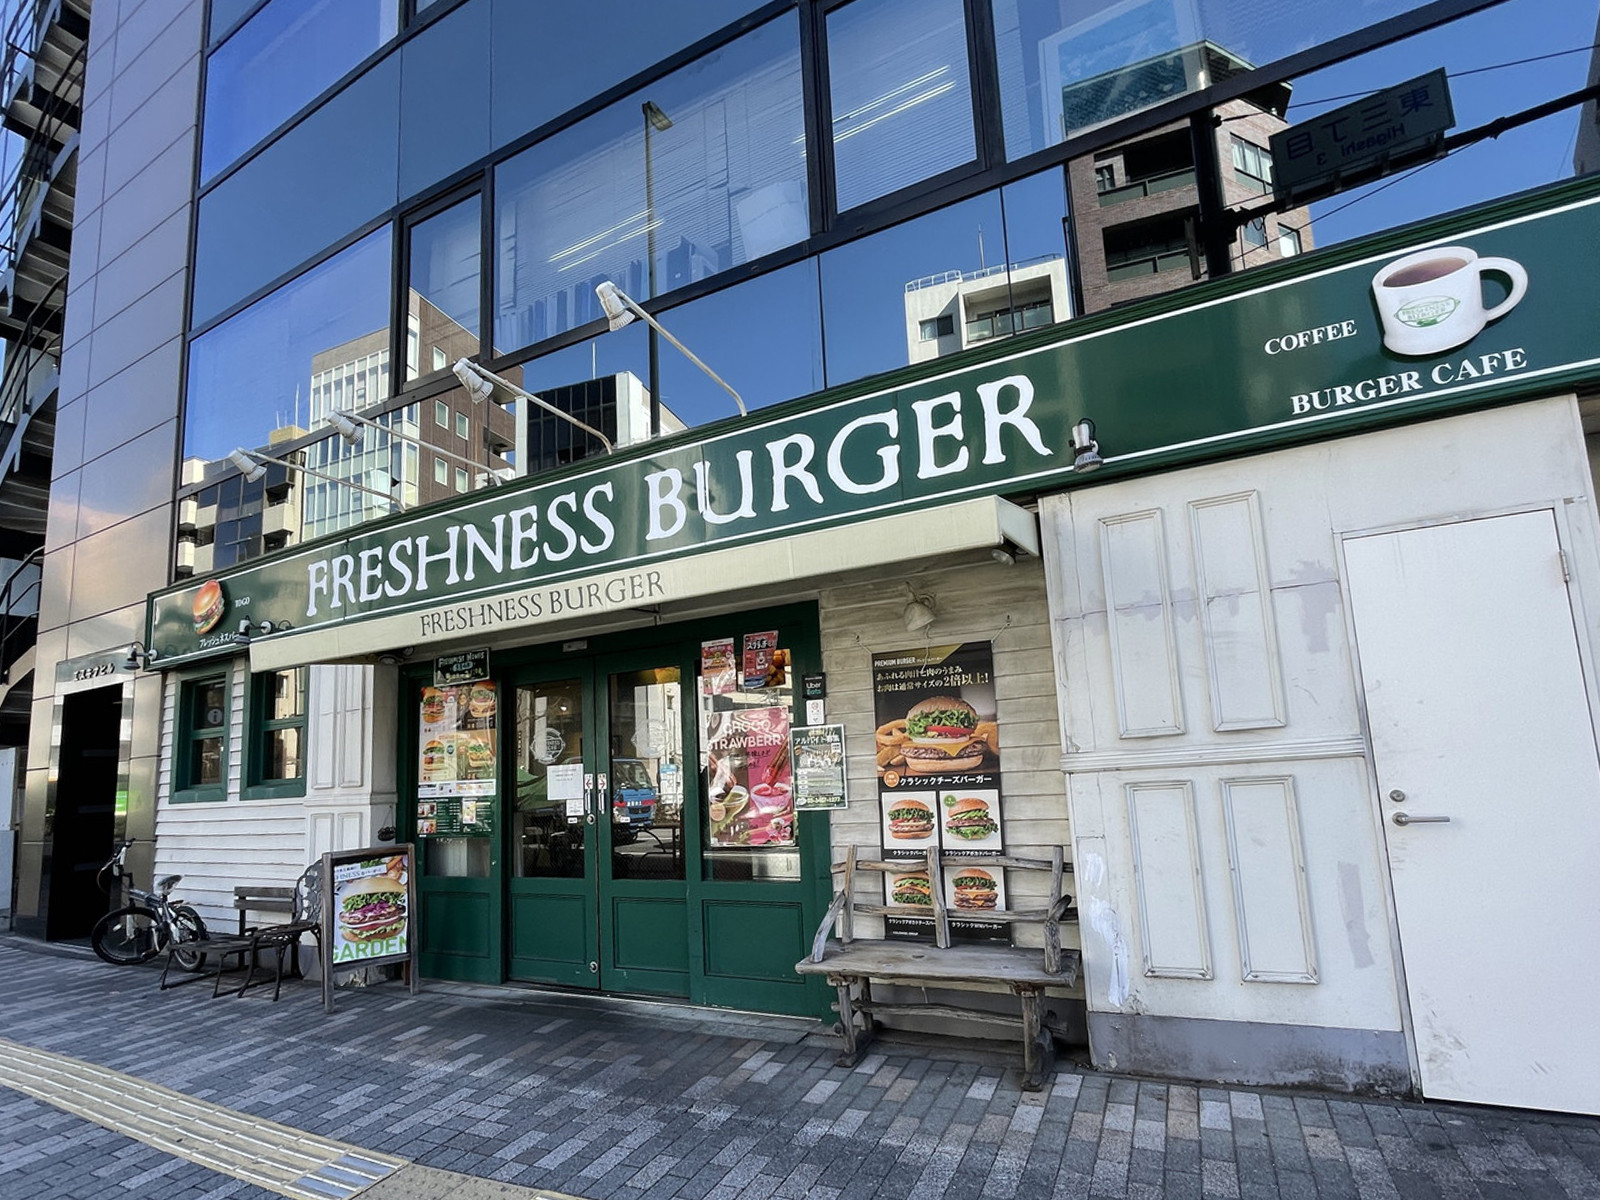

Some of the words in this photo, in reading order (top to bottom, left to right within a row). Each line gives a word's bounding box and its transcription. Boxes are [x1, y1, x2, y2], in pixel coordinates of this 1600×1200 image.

[1264, 319, 1358, 355] COFFEE
[1291, 371, 1424, 416] BURGER
[1431, 347, 1528, 386] CAFE
[306, 480, 616, 618] FRESHNESS
[644, 374, 1054, 542] BURGER
[419, 594, 543, 638] FRESHNESS
[549, 570, 665, 614] BURGER
[199, 631, 240, 648] フレッシュネスバー
[899, 775, 993, 787] クラシックチーズバーガー
[888, 918, 936, 926] クラシックアボカドチーズバー
